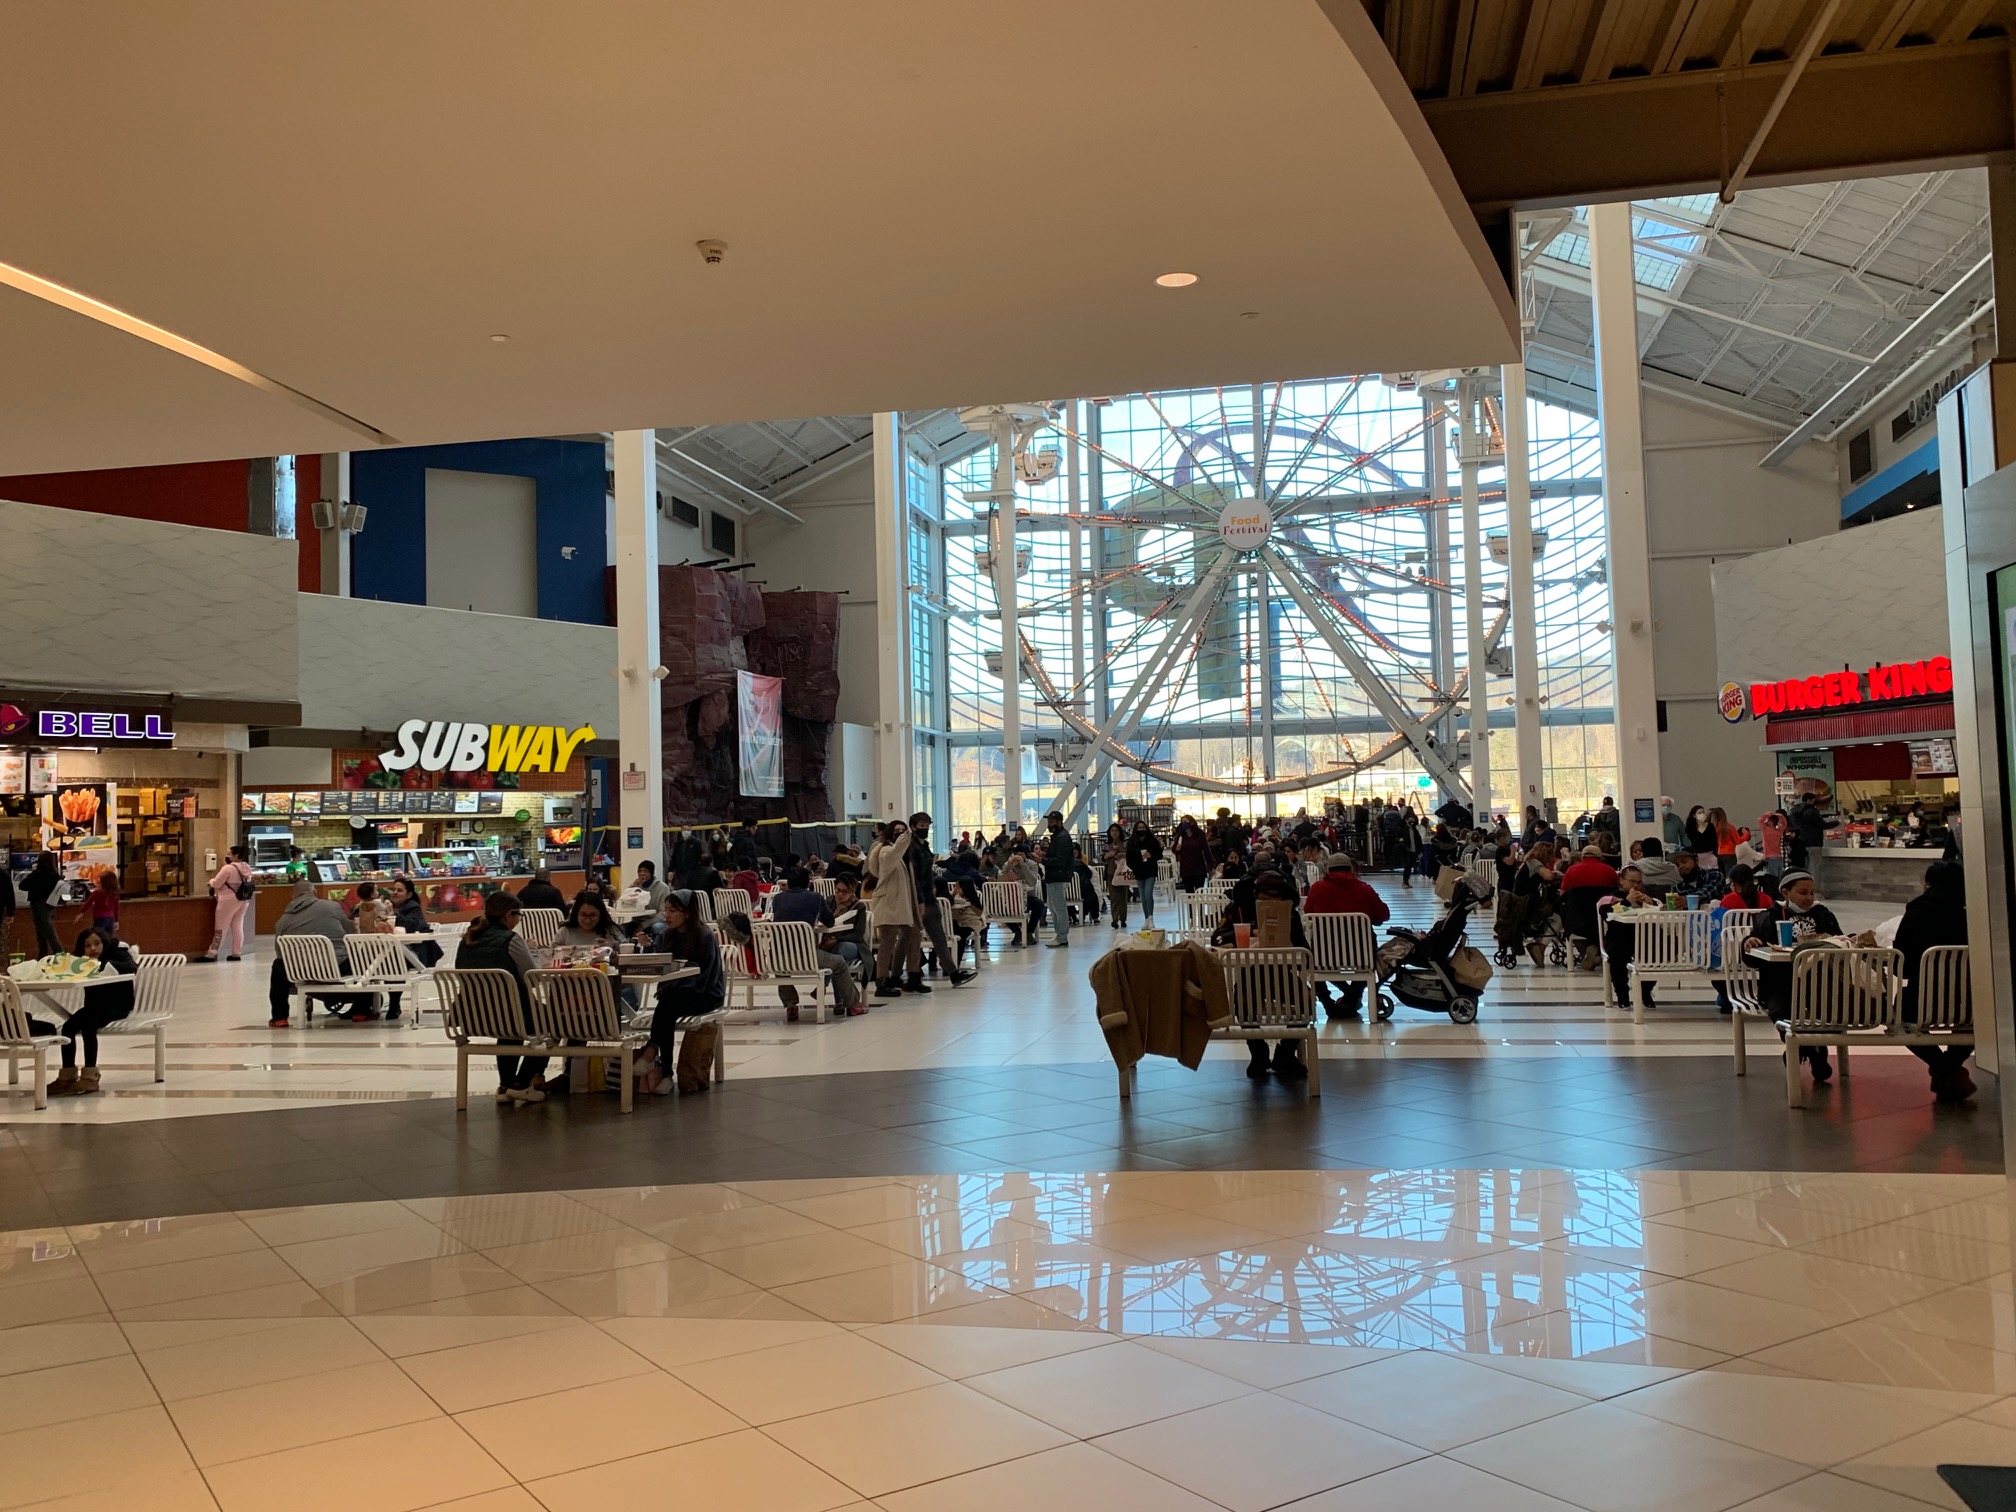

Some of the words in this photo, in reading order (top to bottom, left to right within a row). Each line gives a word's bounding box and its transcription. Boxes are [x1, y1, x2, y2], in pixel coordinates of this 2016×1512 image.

[1223, 523, 1268, 535] Festival
[1231, 514, 1260, 525] Food
[1750, 670, 1862, 717] BURGER
[1868, 656, 1953, 701] KING
[1722, 695, 1743, 714] KING
[38, 710, 176, 739] BELL
[378, 719, 597, 774] SUBWAY
